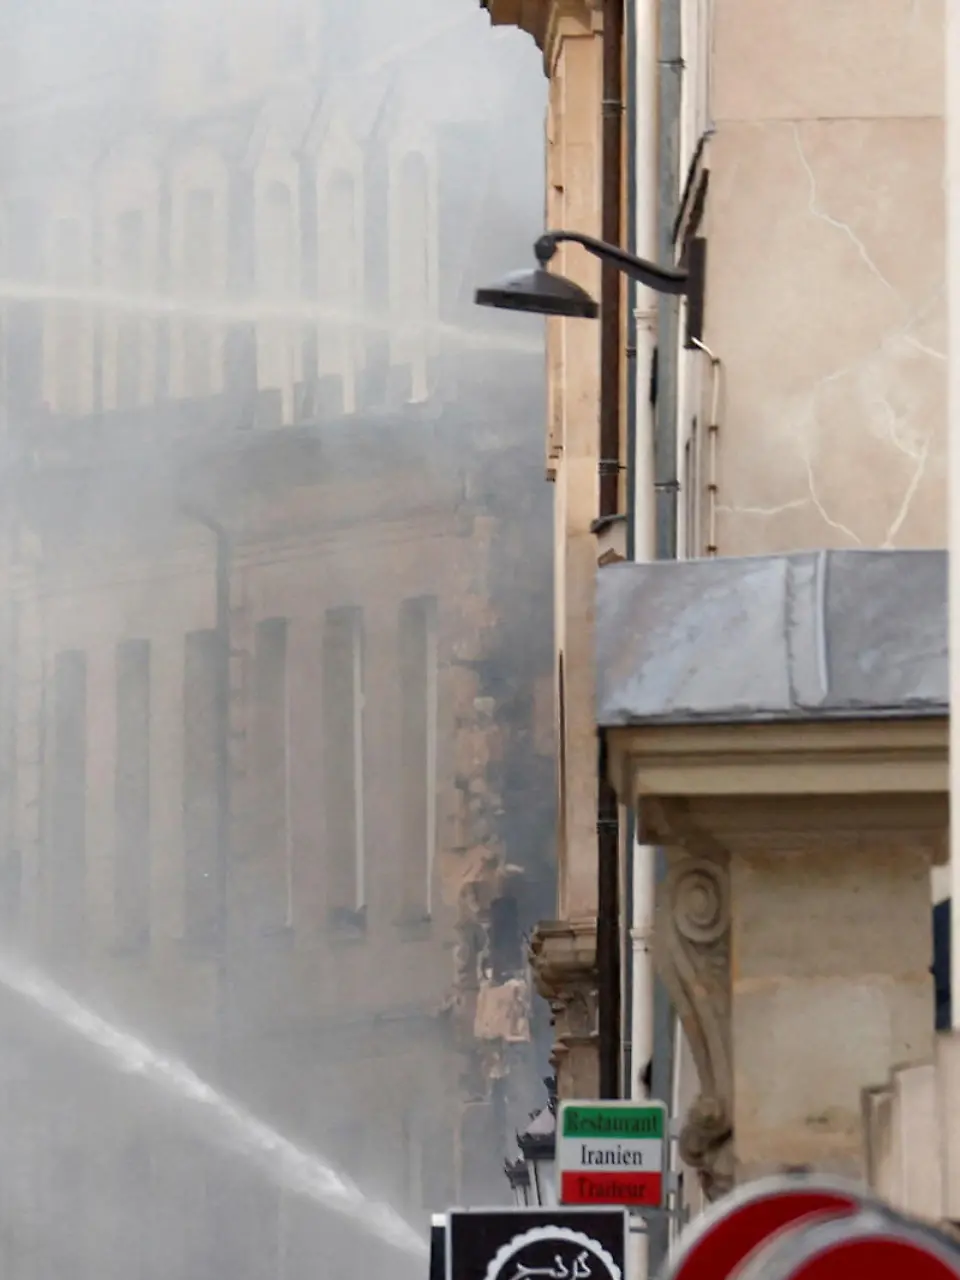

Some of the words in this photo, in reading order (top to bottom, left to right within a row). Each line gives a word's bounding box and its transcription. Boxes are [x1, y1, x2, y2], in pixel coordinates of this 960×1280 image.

[566, 1111, 657, 1132] Restaurant
[581, 1143, 643, 1166] Iranien
[577, 1177, 645, 1198] Traiteur
